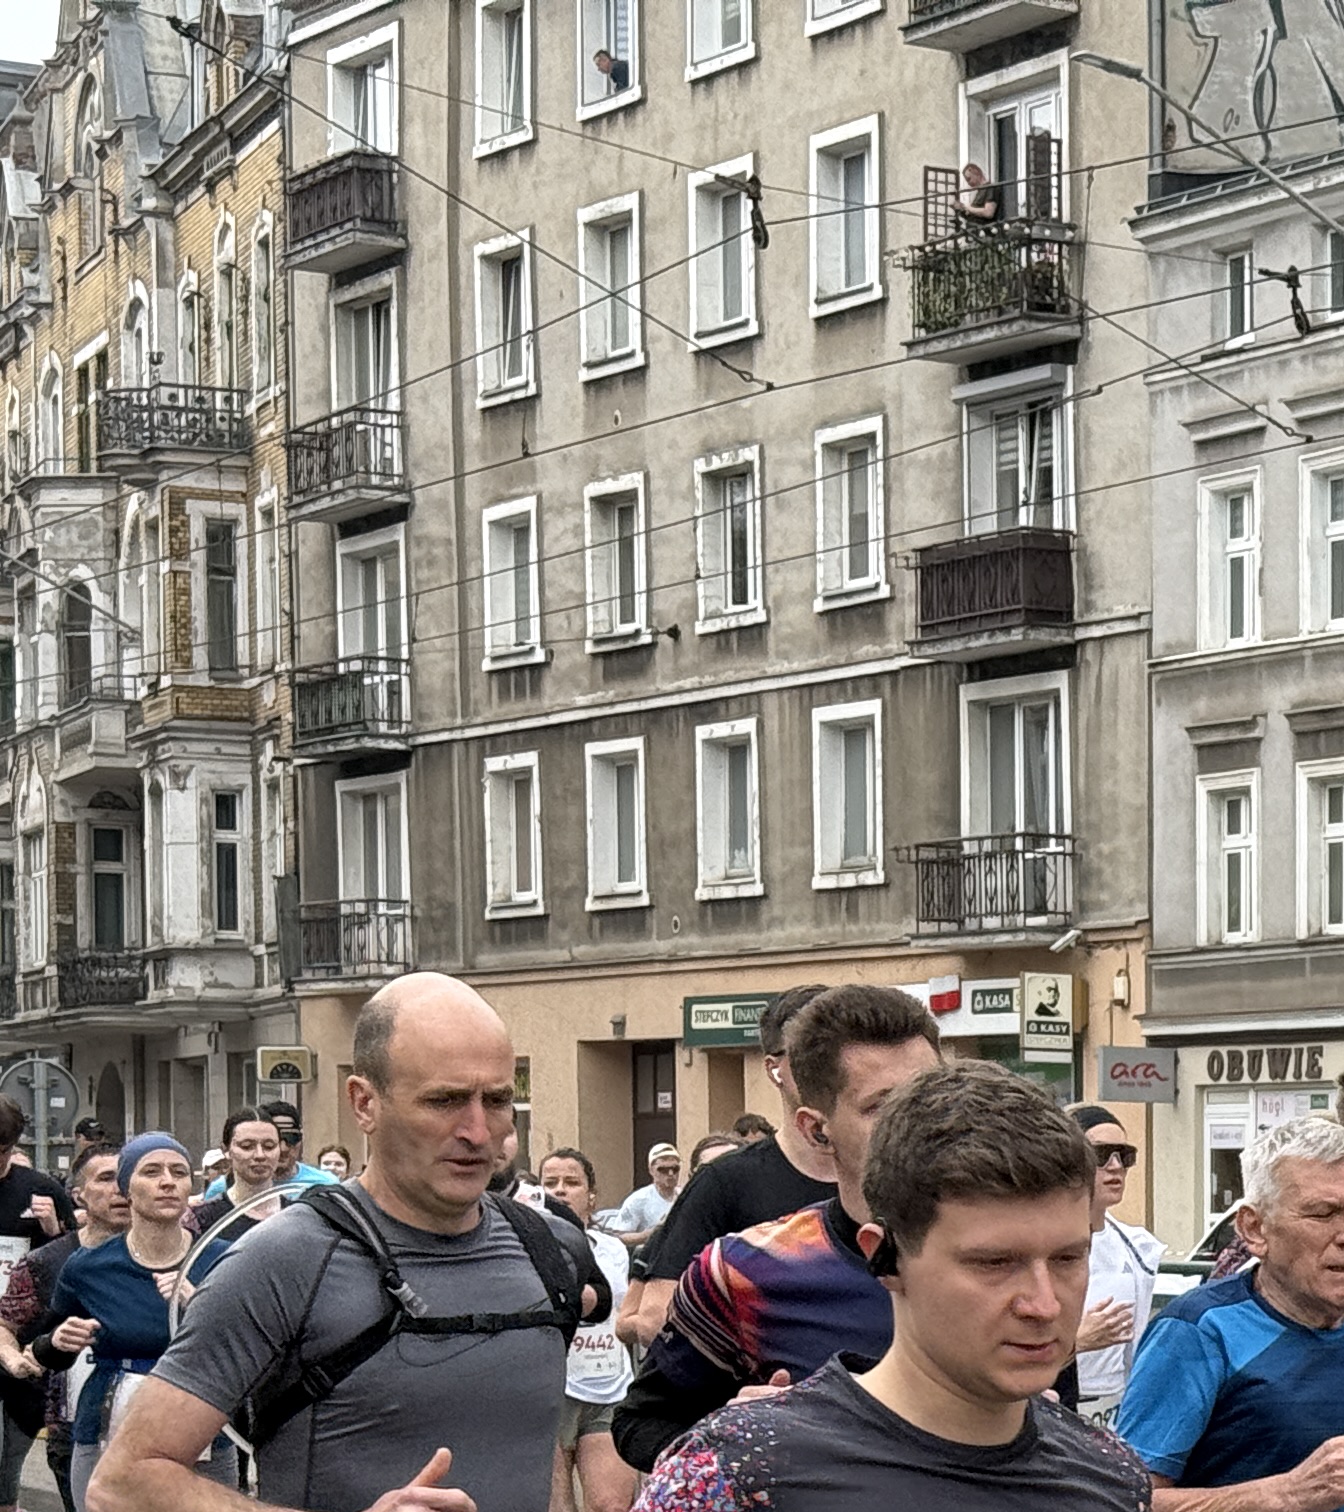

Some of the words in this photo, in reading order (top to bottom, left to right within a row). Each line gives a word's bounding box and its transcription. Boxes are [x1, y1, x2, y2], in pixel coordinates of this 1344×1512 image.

[1110, 1062, 1169, 1081] ara
[1207, 1045, 1324, 1082] OBUWIE
[573, 1333, 615, 1352] 9442
